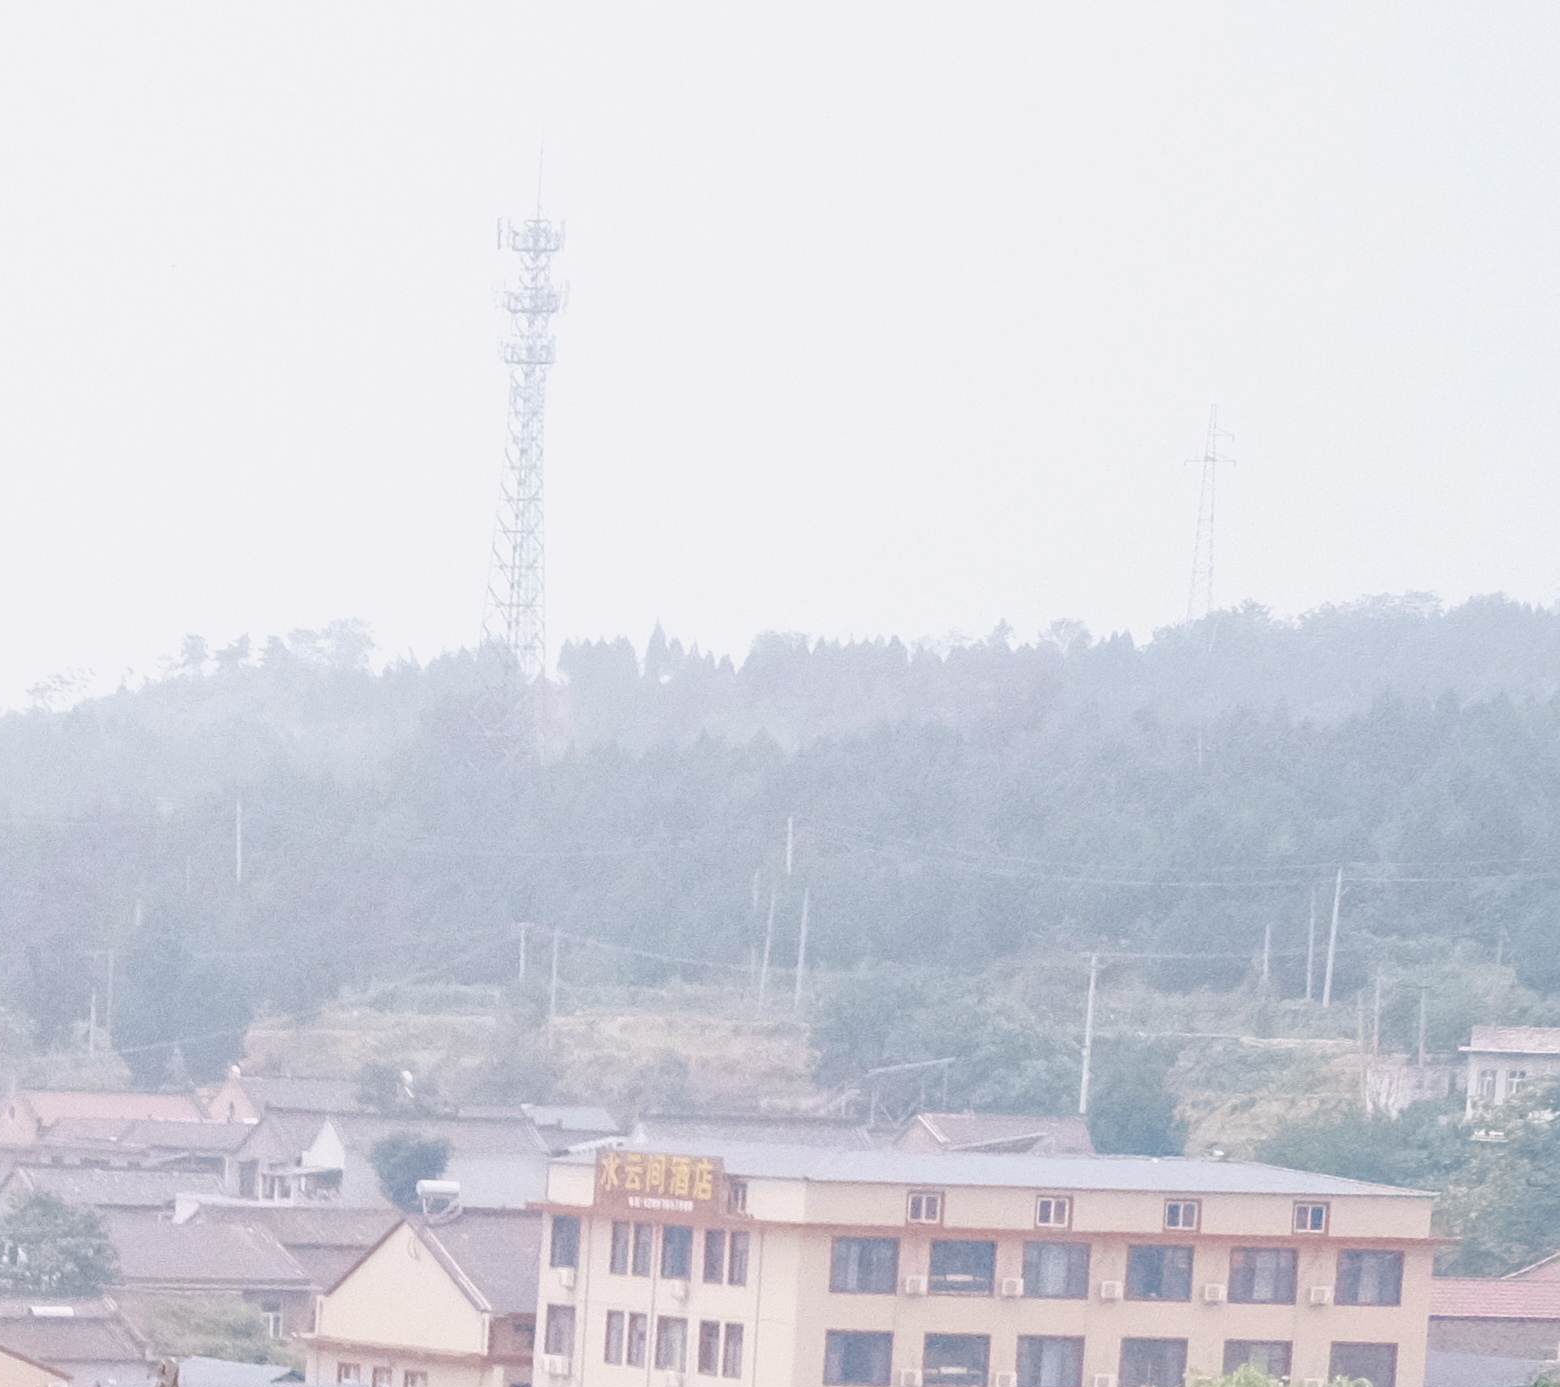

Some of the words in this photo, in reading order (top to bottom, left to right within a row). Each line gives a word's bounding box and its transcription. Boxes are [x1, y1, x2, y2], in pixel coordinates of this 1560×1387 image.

[599, 1152, 714, 1201] 水云间酒店
